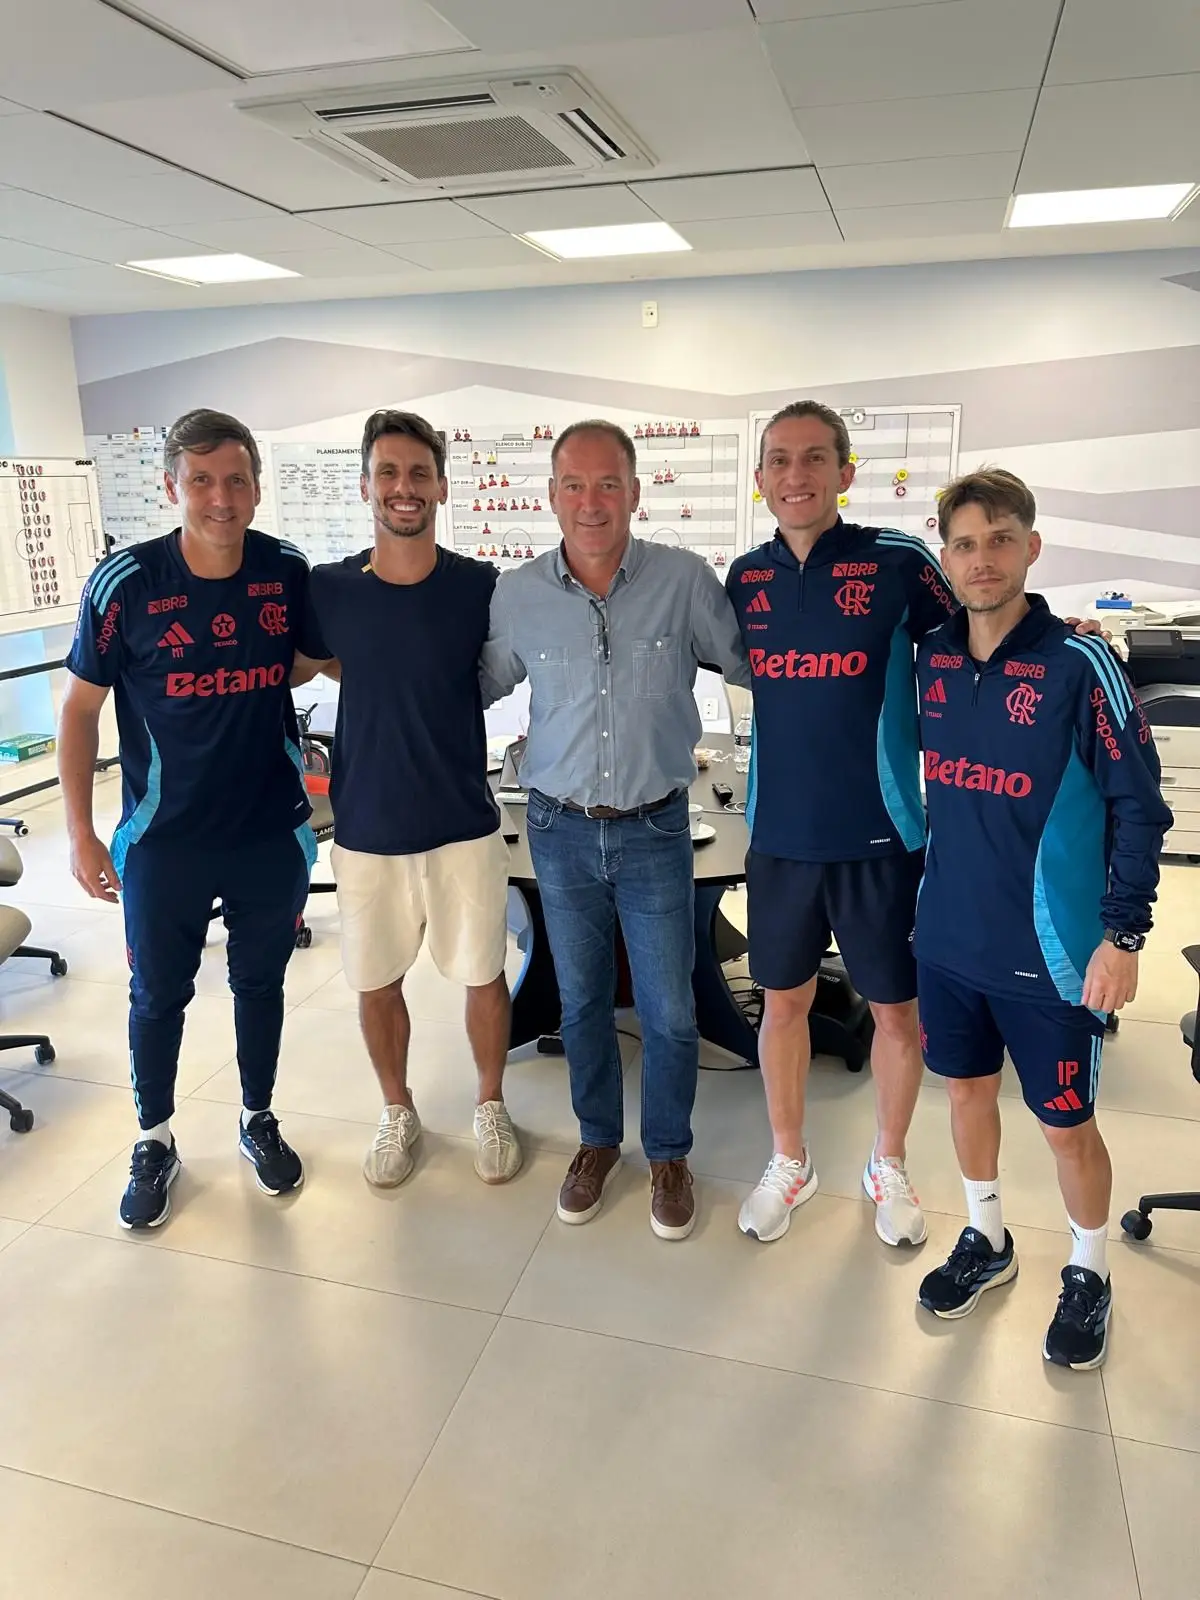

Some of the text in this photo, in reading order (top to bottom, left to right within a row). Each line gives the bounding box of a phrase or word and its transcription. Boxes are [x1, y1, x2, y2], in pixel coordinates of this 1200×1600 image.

[751, 569, 775, 582] BRB
[847, 563, 879, 577] BRB
[257, 582, 284, 596] BRB
[161, 595, 188, 612] BRB
[171, 647, 184, 659] MT
[749, 648, 868, 679] Betano
[940, 655, 963, 669] BRB
[1016, 663, 1046, 679] BRB
[166, 663, 285, 697] Betano
[1089, 687, 1121, 761] Shopee
[925, 749, 1032, 798] Betano
[1057, 1060, 1079, 1086] IP
